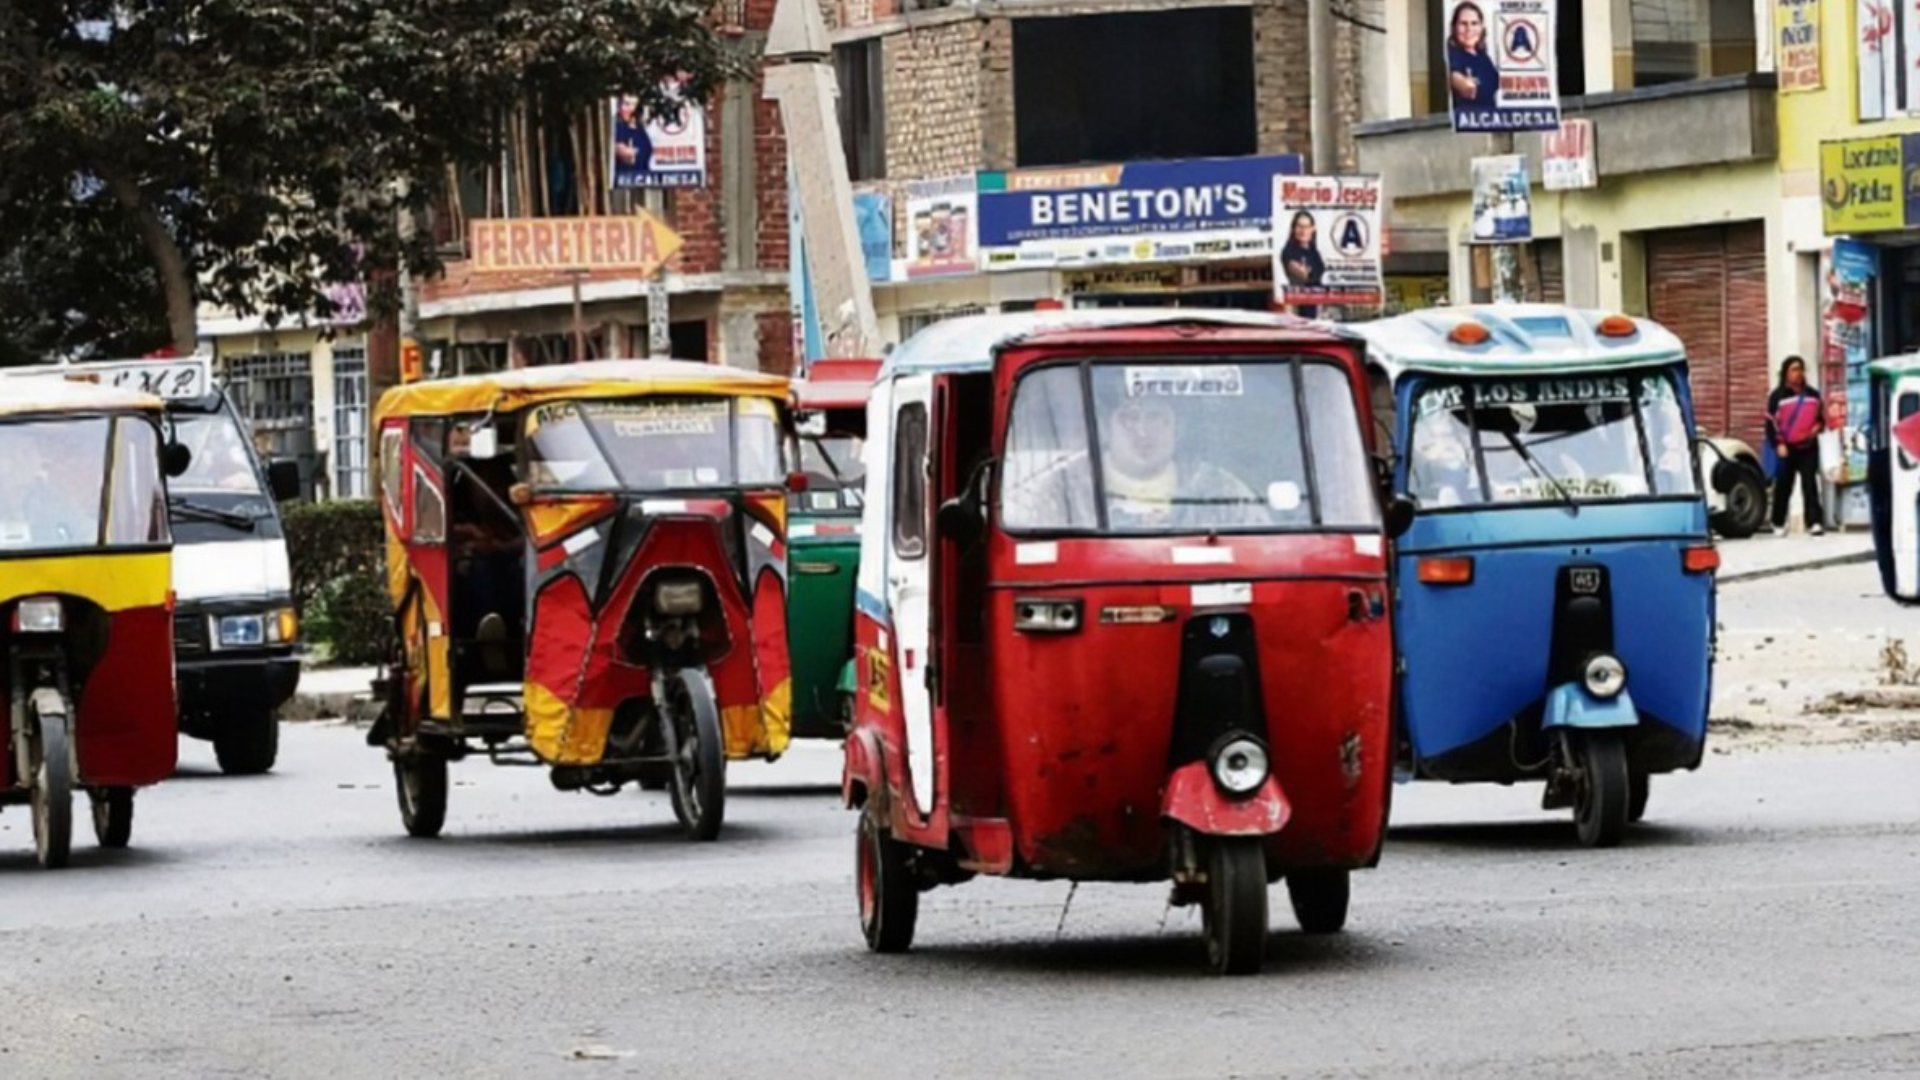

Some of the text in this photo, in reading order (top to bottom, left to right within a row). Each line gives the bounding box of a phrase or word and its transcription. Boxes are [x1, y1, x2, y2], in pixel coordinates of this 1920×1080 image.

[1458, 110, 1555, 127] ALCALDESA
[1031, 184, 1247, 225] BENETOM'S
[476, 219, 661, 264] FERRETERIA
[1341, 219, 1363, 249] A
[1473, 382, 1527, 403] LOS
